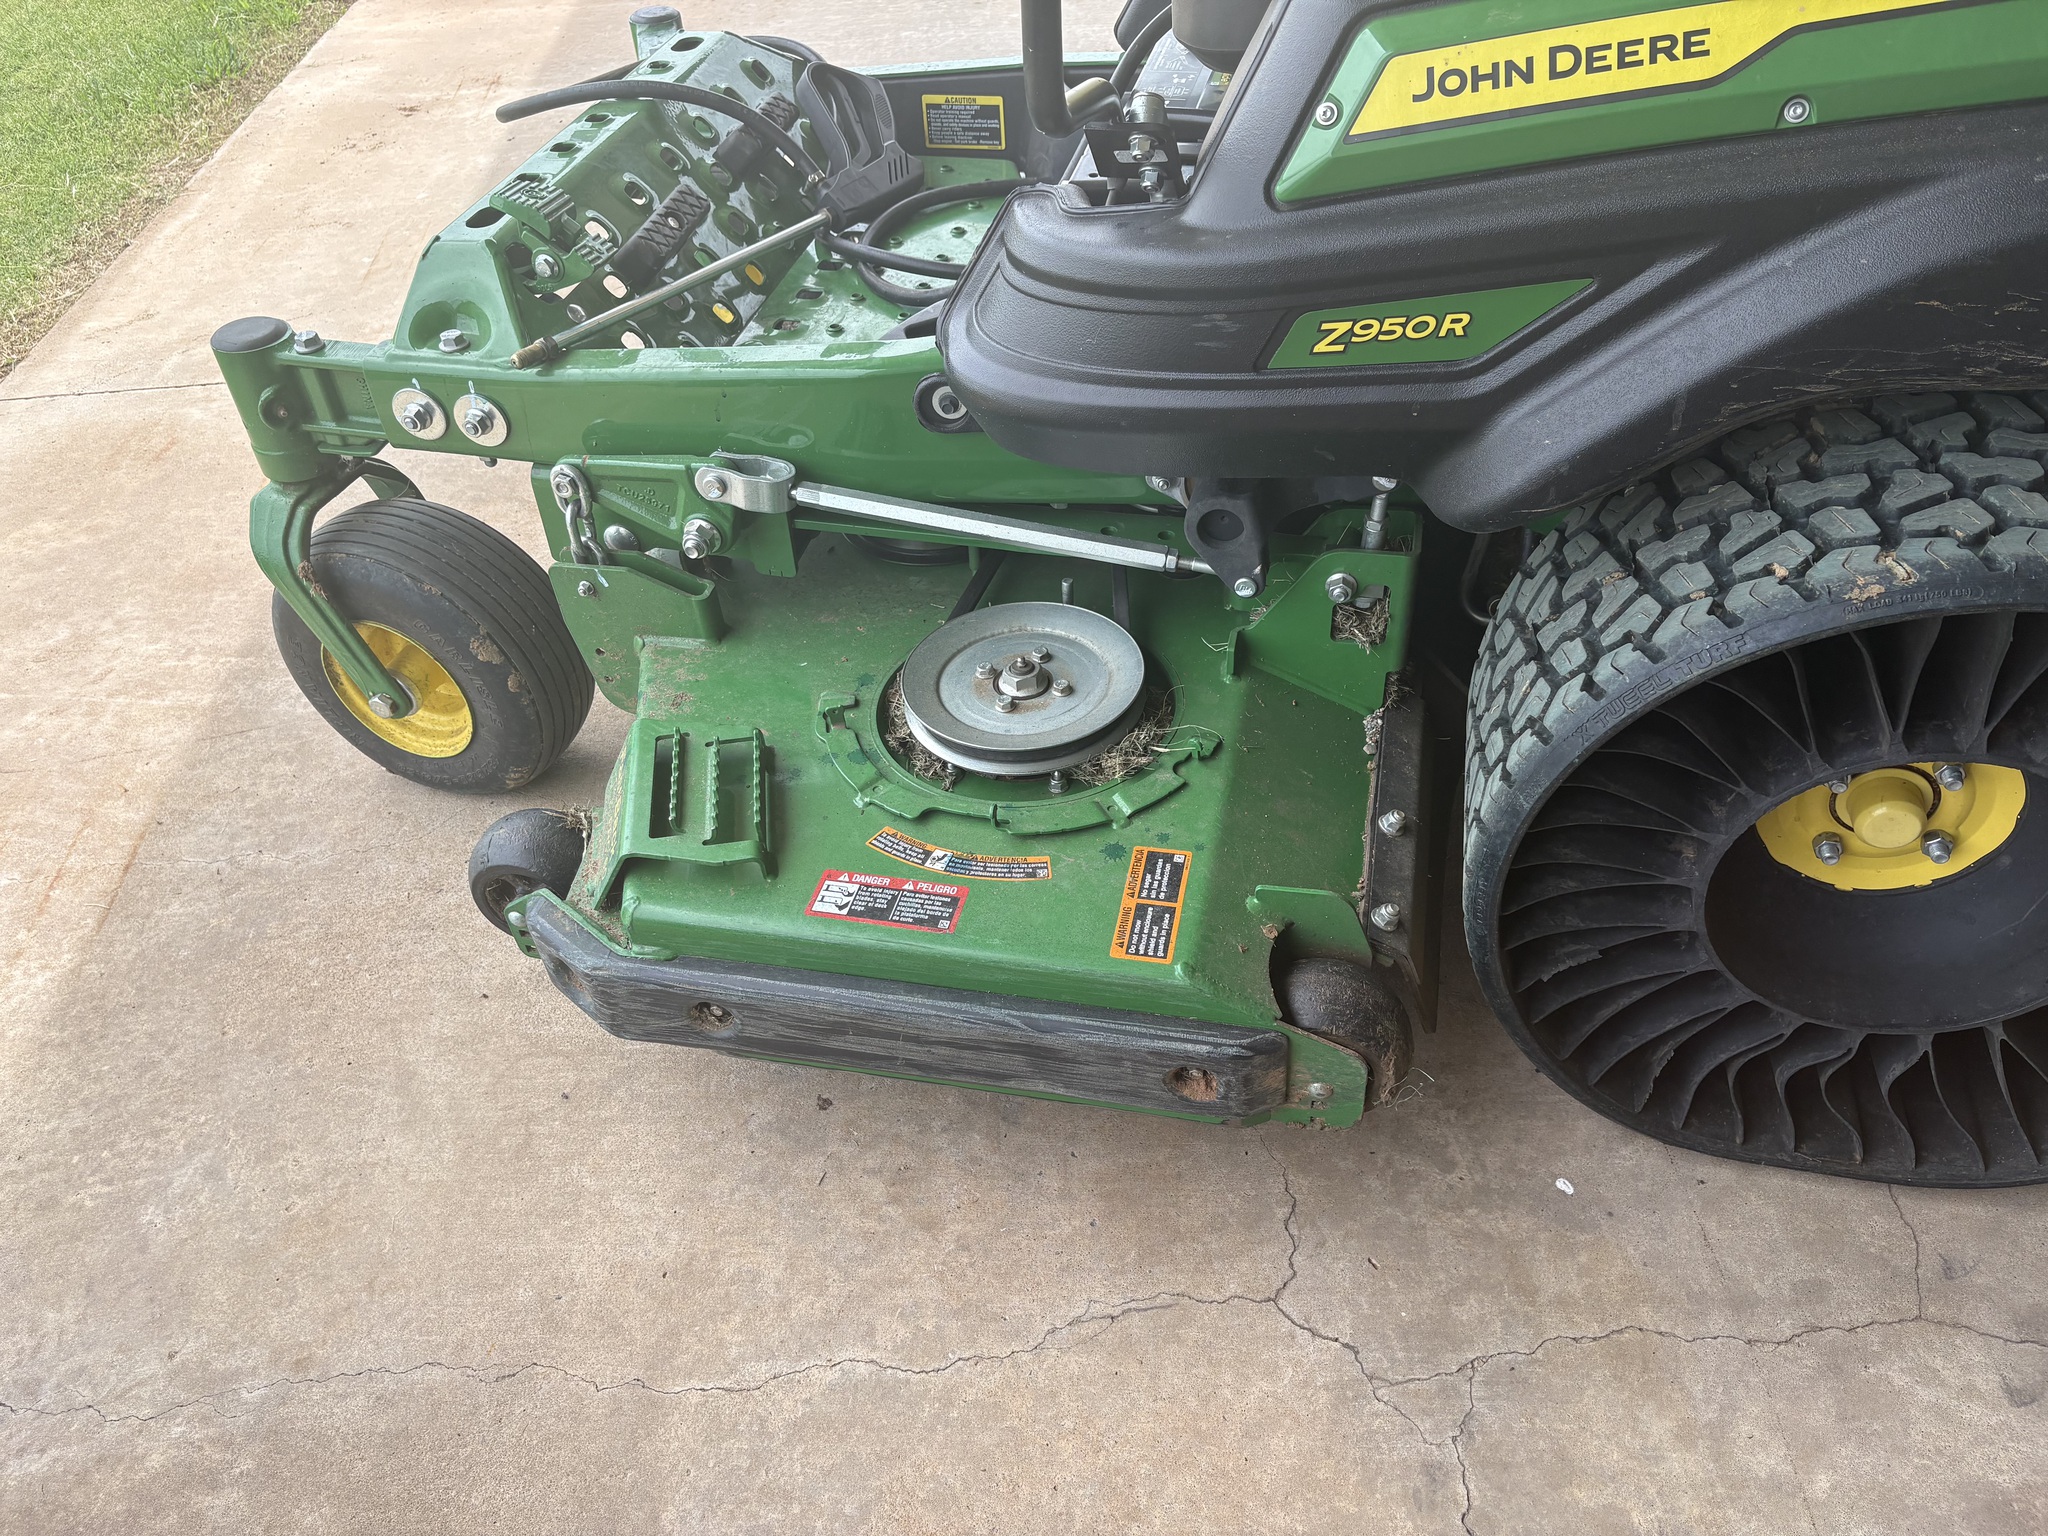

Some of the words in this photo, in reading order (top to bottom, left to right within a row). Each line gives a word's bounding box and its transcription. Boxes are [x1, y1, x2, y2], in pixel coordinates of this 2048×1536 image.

[1412, 55, 1534, 103] JOHN
[1548, 27, 1711, 81] DEERE
[1311, 311, 1472, 355] Z950R
[1868, 598, 1893, 610] LOAD
[412, 618, 505, 729] CARLISLE
[1574, 720, 1595, 746] X
[1592, 671, 1673, 729] TWEEL
[1675, 633, 1748, 677] TURF
[886, 835, 900, 844] avoid
[898, 841, 913, 851] injury
[900, 833, 928, 849] WARNING
[905, 849, 917, 858] keep
[980, 855, 1028, 863] ADVERTENCIA
[946, 866, 966, 874] escudos
[1127, 849, 1145, 892] ADVERTENCIA
[1154, 858, 1164, 880] guardas
[852, 873, 891, 886] DANGER
[1143, 873, 1152, 889] segar
[1151, 880, 1160, 889] las
[883, 888, 899, 896] injury
[916, 882, 958, 895] PELIGRO
[1140, 888, 1148, 898] No
[1149, 889, 1157, 899] sin
[871, 892, 892, 900] rotating
[901, 896, 924, 904] causadas
[930, 894, 951, 902] lesiones
[1158, 892, 1166, 900] de
[897, 905, 916, 913] alejado
[899, 900, 922, 909] cuchillas,
[901, 911, 928, 919] plataforma
[1162, 913, 1171, 930] place
[1115, 906, 1133, 941] WARNING
[1128, 944, 1137, 954] Do
[1133, 919, 1142, 934] mow
[1138, 933, 1148, 955] without
[1143, 906, 1154, 934] enclosure
[1159, 929, 1167, 937] in
[1147, 937, 1157, 956] shield
[1157, 936, 1166, 957] guards
